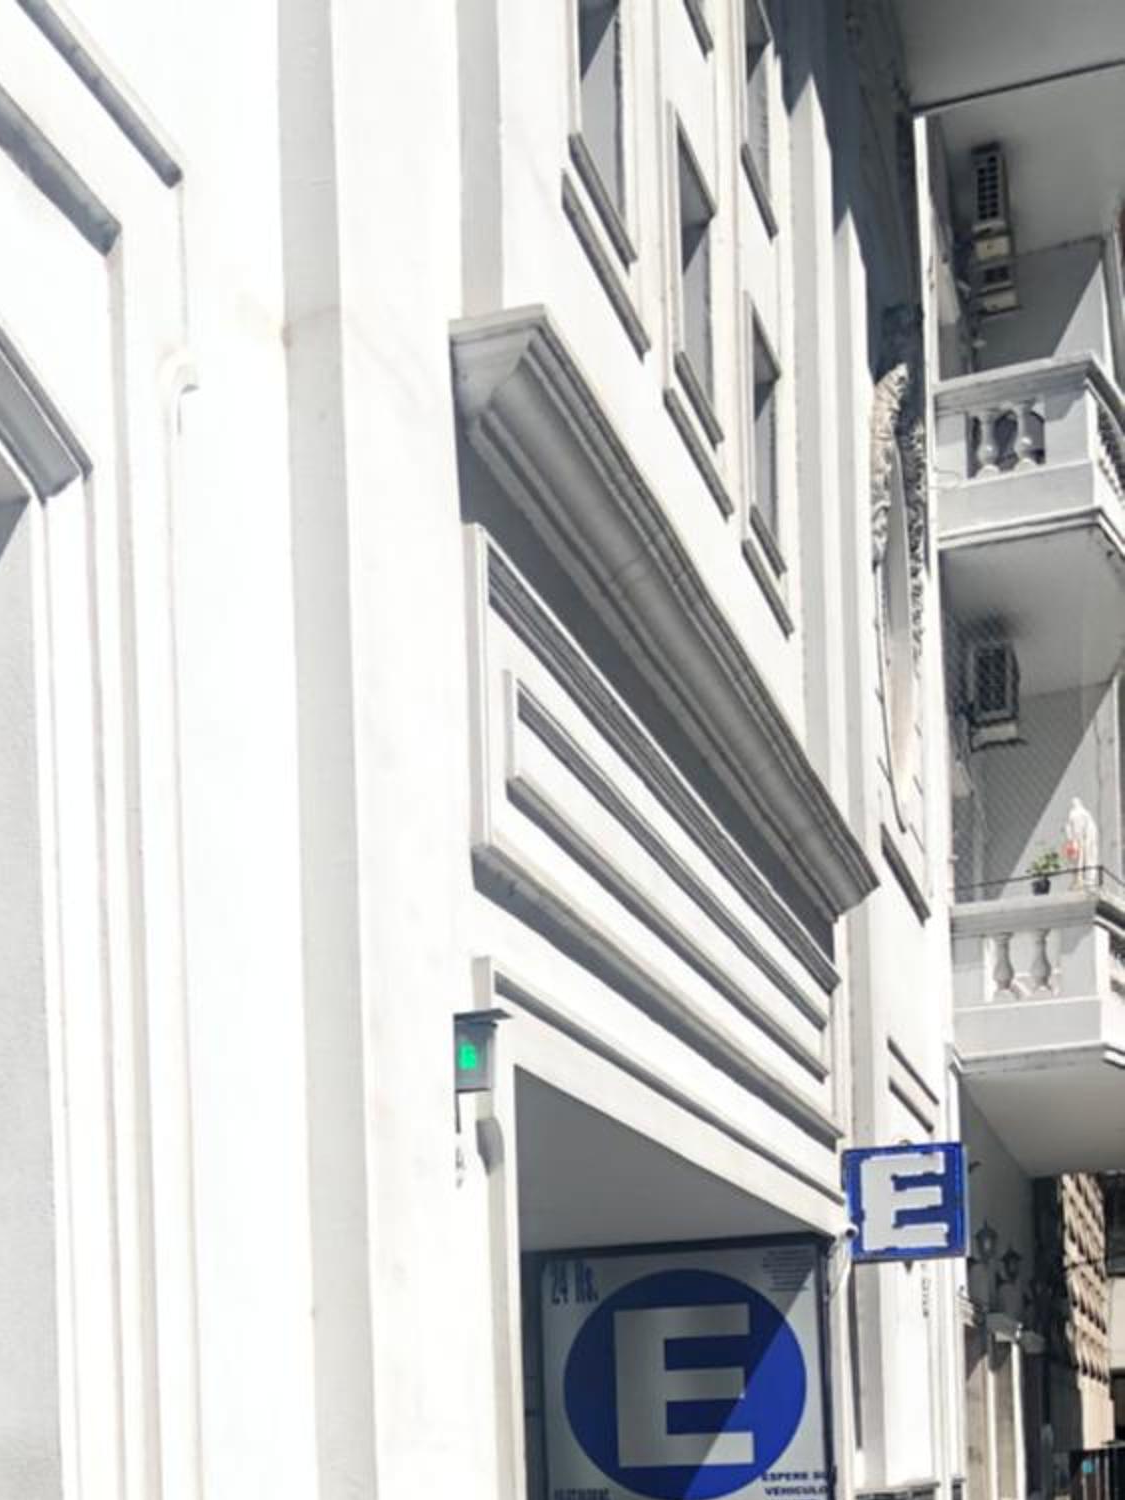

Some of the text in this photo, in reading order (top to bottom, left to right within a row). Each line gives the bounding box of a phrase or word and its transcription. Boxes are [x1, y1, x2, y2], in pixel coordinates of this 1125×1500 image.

[860, 1150, 949, 1251] E
[613, 1302, 755, 1468] E
[762, 1471, 808, 1482] ESPERE
[765, 1486, 828, 1497] VEHICULO
